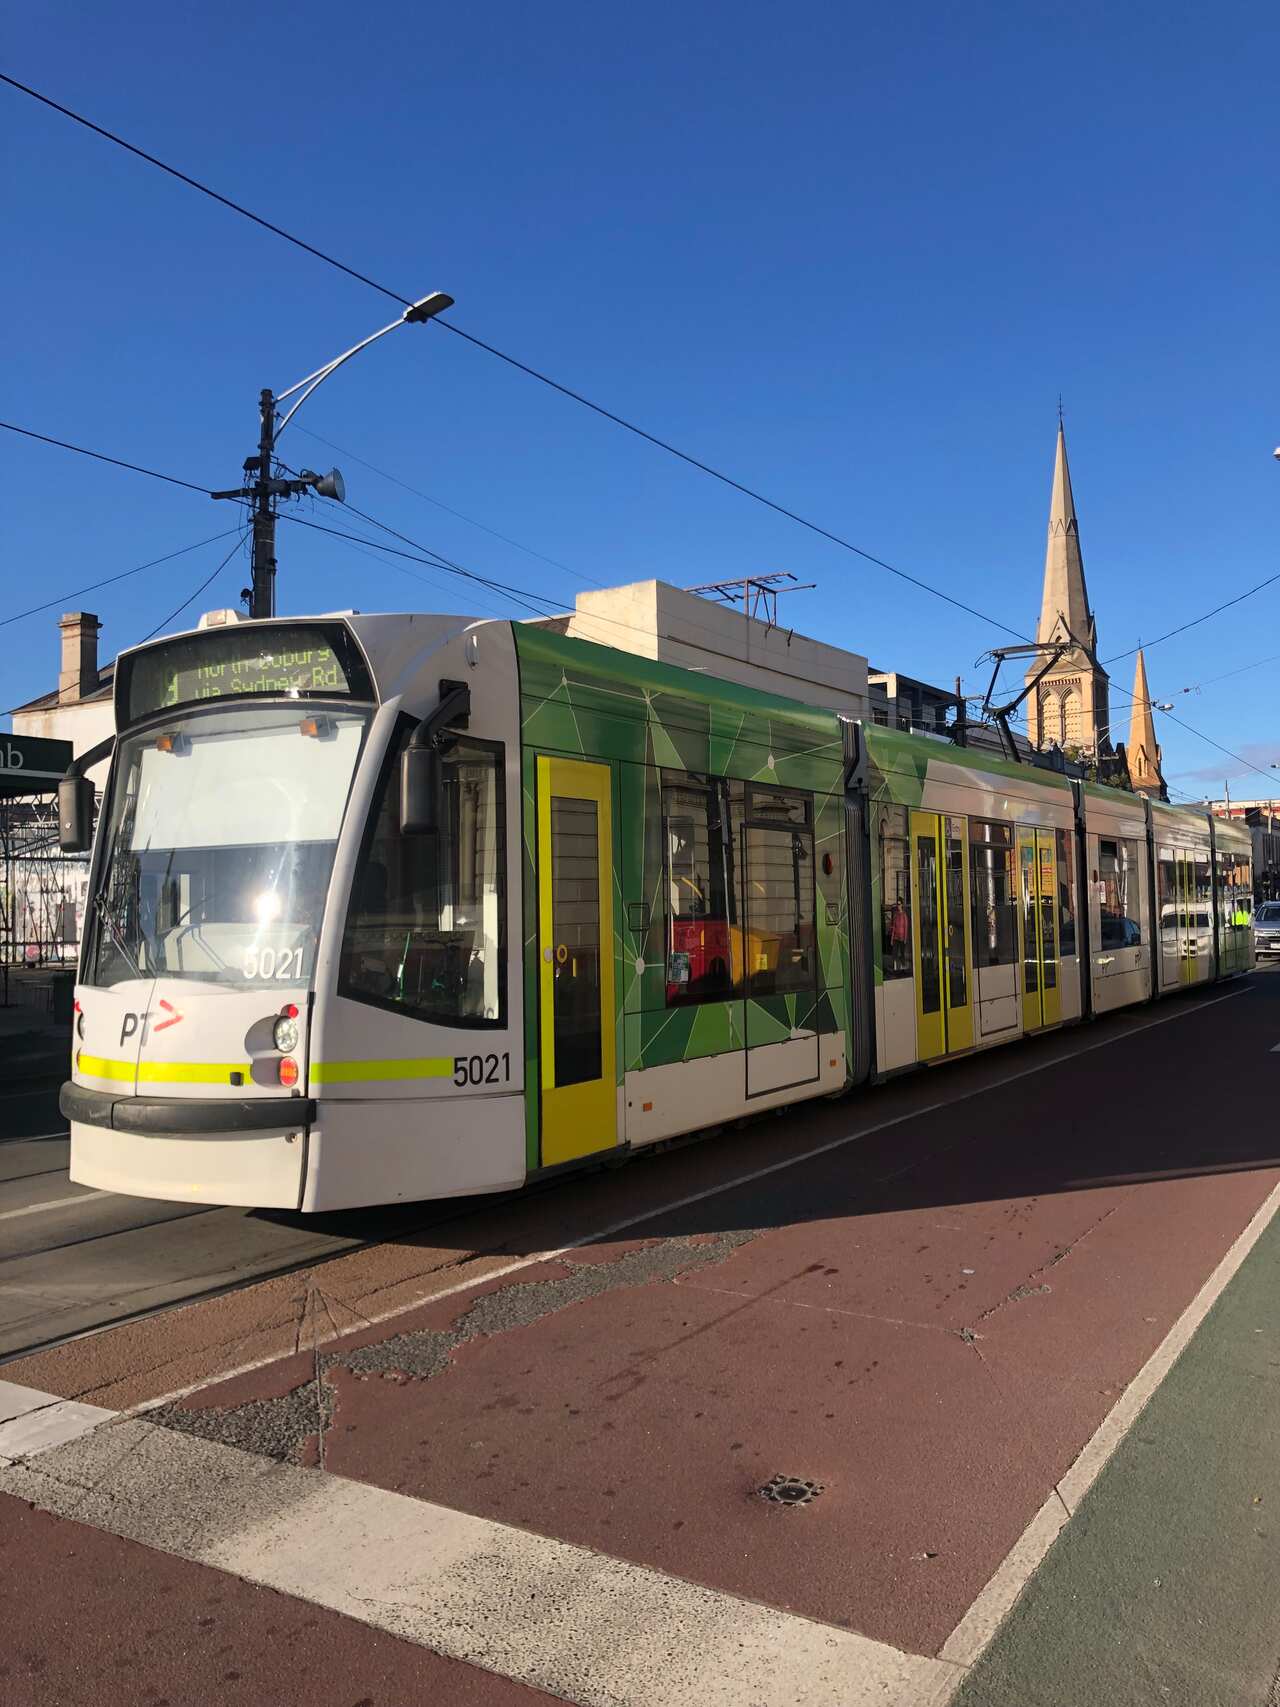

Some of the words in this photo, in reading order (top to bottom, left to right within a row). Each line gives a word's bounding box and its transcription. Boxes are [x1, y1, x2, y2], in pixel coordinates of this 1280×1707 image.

[312, 664, 337, 687] Rd
[243, 947, 304, 979] 5021
[454, 1052, 510, 1087] 5021
